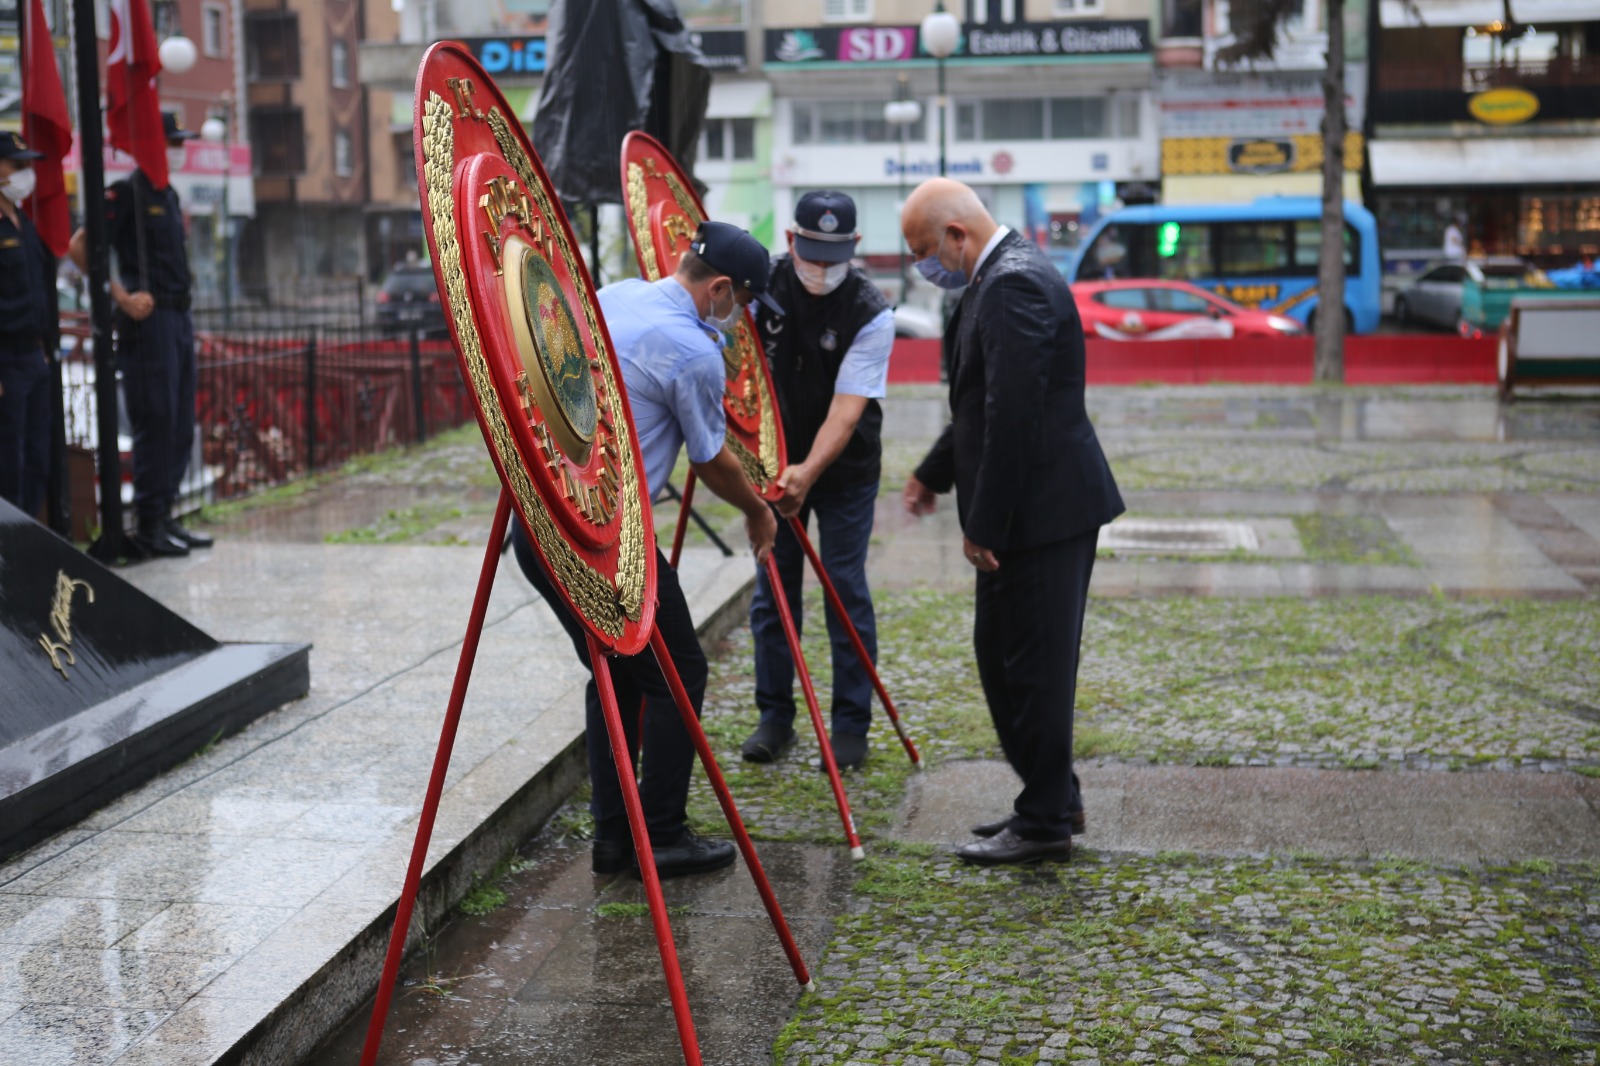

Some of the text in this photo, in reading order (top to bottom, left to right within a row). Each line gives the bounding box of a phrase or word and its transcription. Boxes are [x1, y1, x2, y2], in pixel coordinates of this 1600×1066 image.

[850, 25, 1143, 61] SD Estetik & Güzellik
